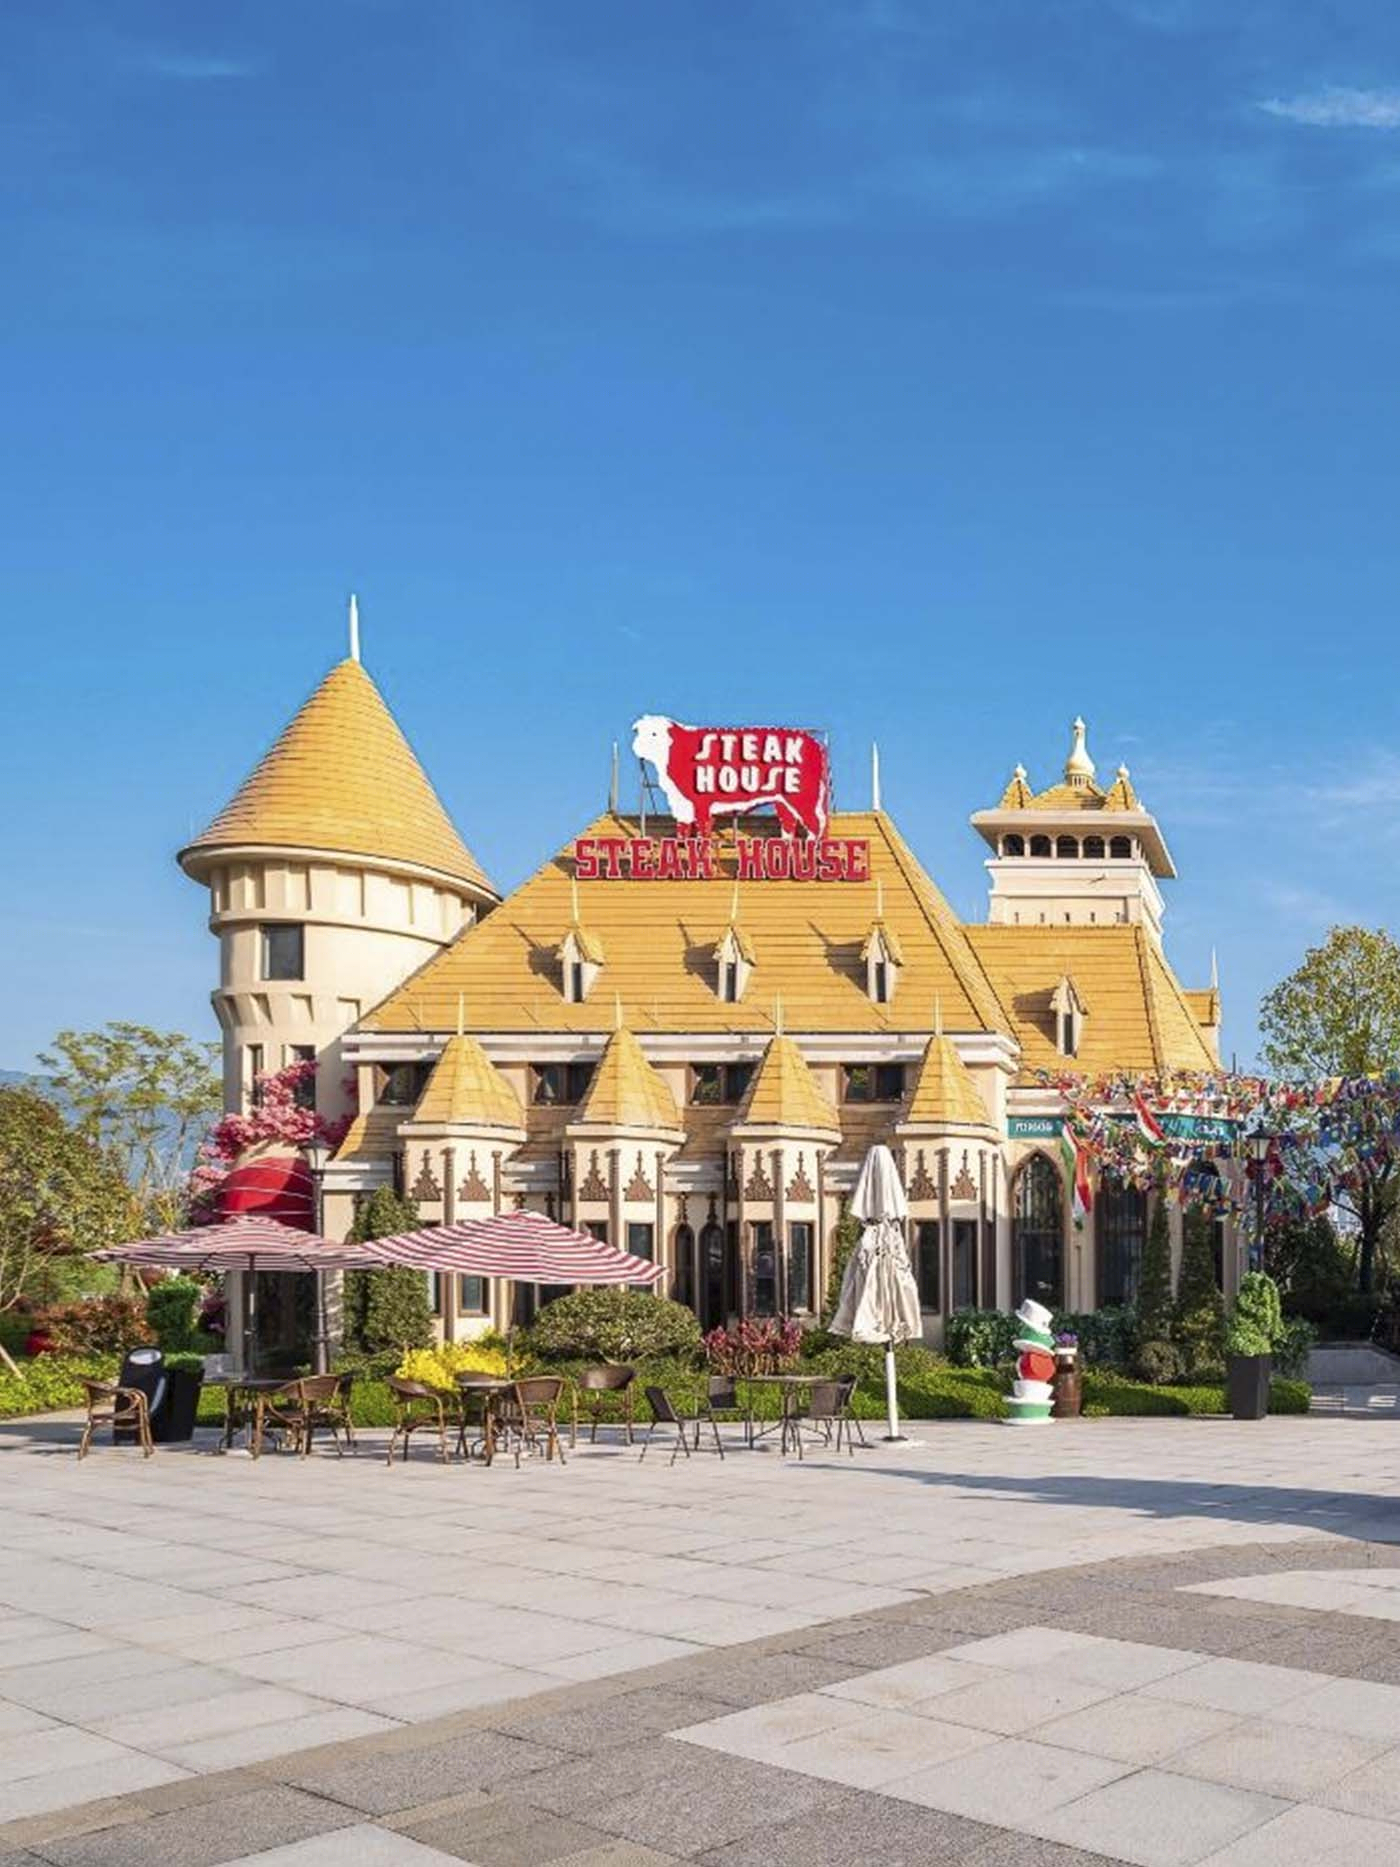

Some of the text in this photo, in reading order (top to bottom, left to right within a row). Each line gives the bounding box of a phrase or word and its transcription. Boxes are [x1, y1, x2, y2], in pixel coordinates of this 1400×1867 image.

[694, 732, 805, 763] STEAK
[695, 765, 801, 793] HOUSE
[575, 837, 869, 881] STEAK HOUSE
